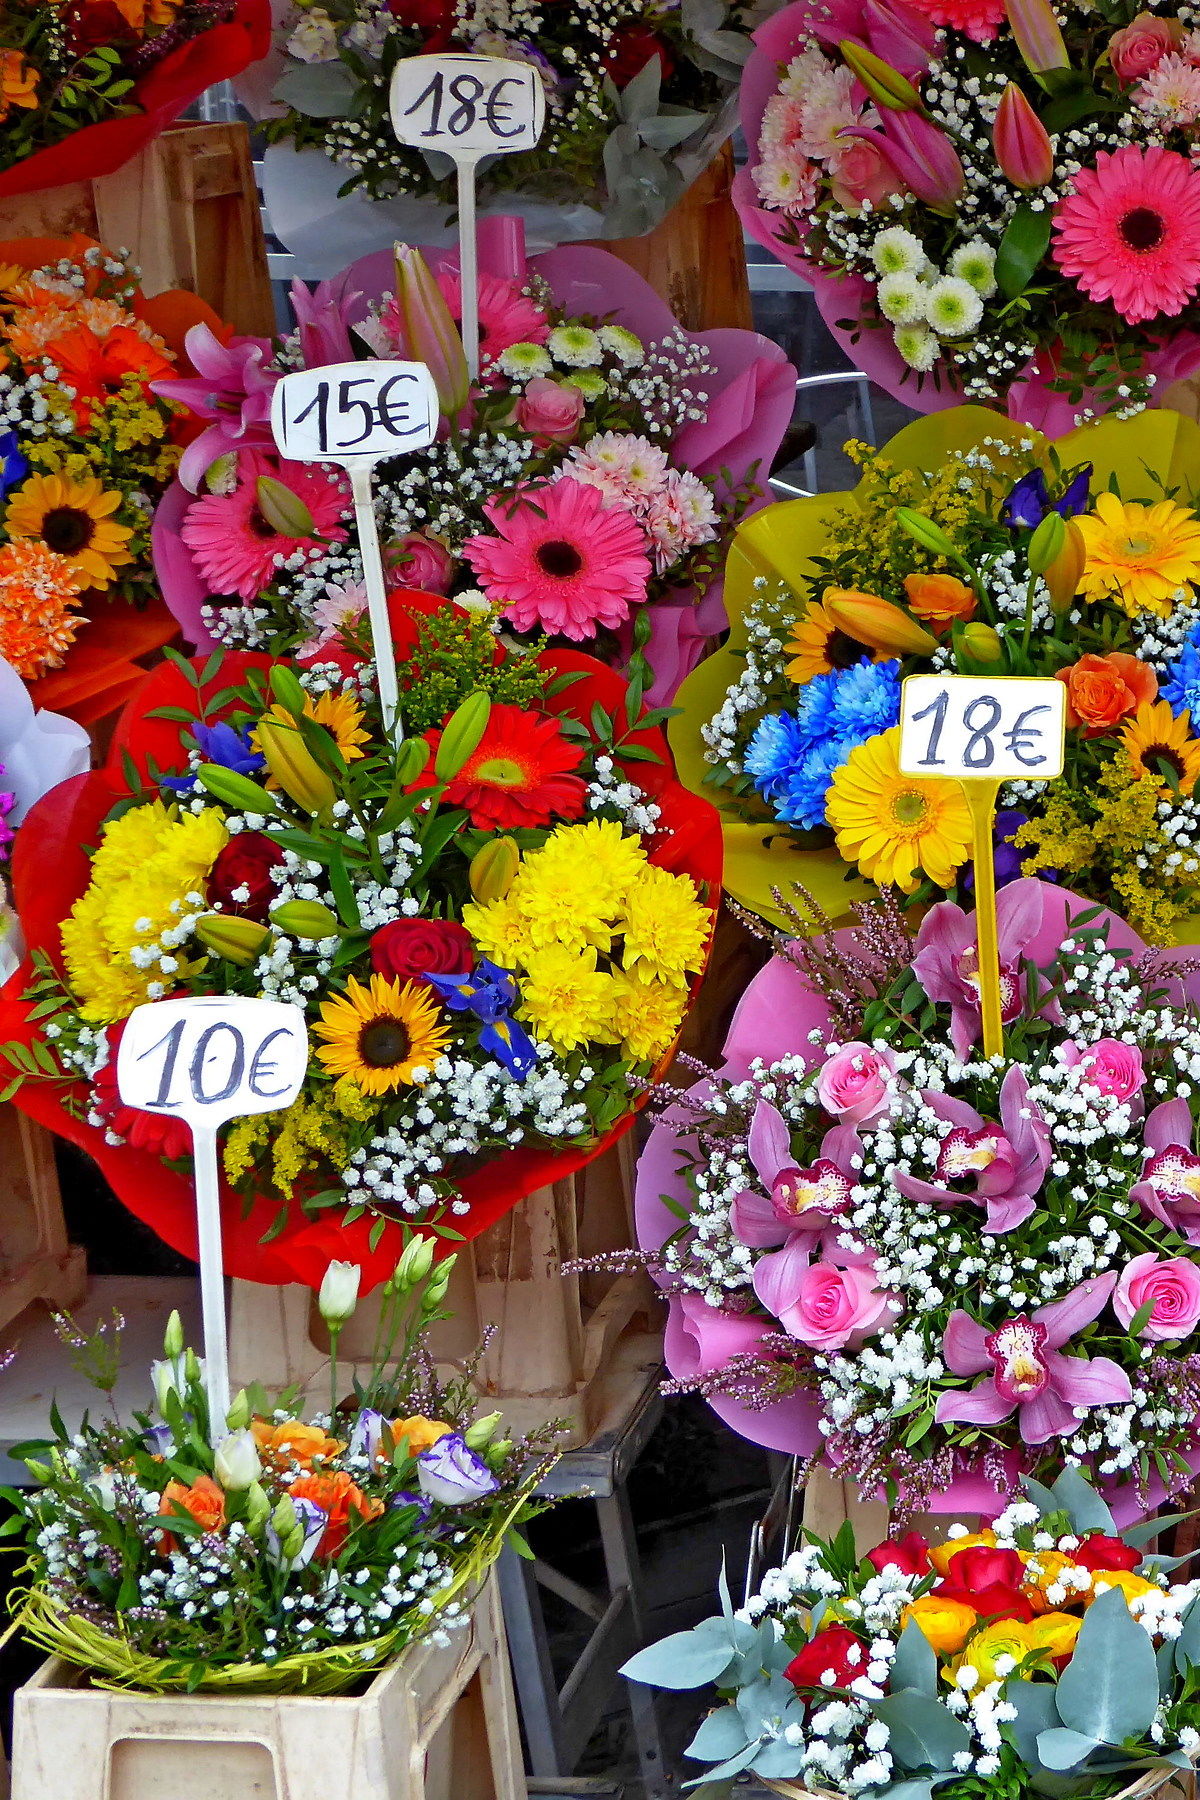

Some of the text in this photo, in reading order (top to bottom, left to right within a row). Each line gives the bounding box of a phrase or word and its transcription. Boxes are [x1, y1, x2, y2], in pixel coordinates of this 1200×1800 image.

[404, 71, 526, 138] 18€
[294, 374, 428, 452] 15€
[911, 690, 1053, 768] 18€
[136, 1018, 295, 1108] 10€
